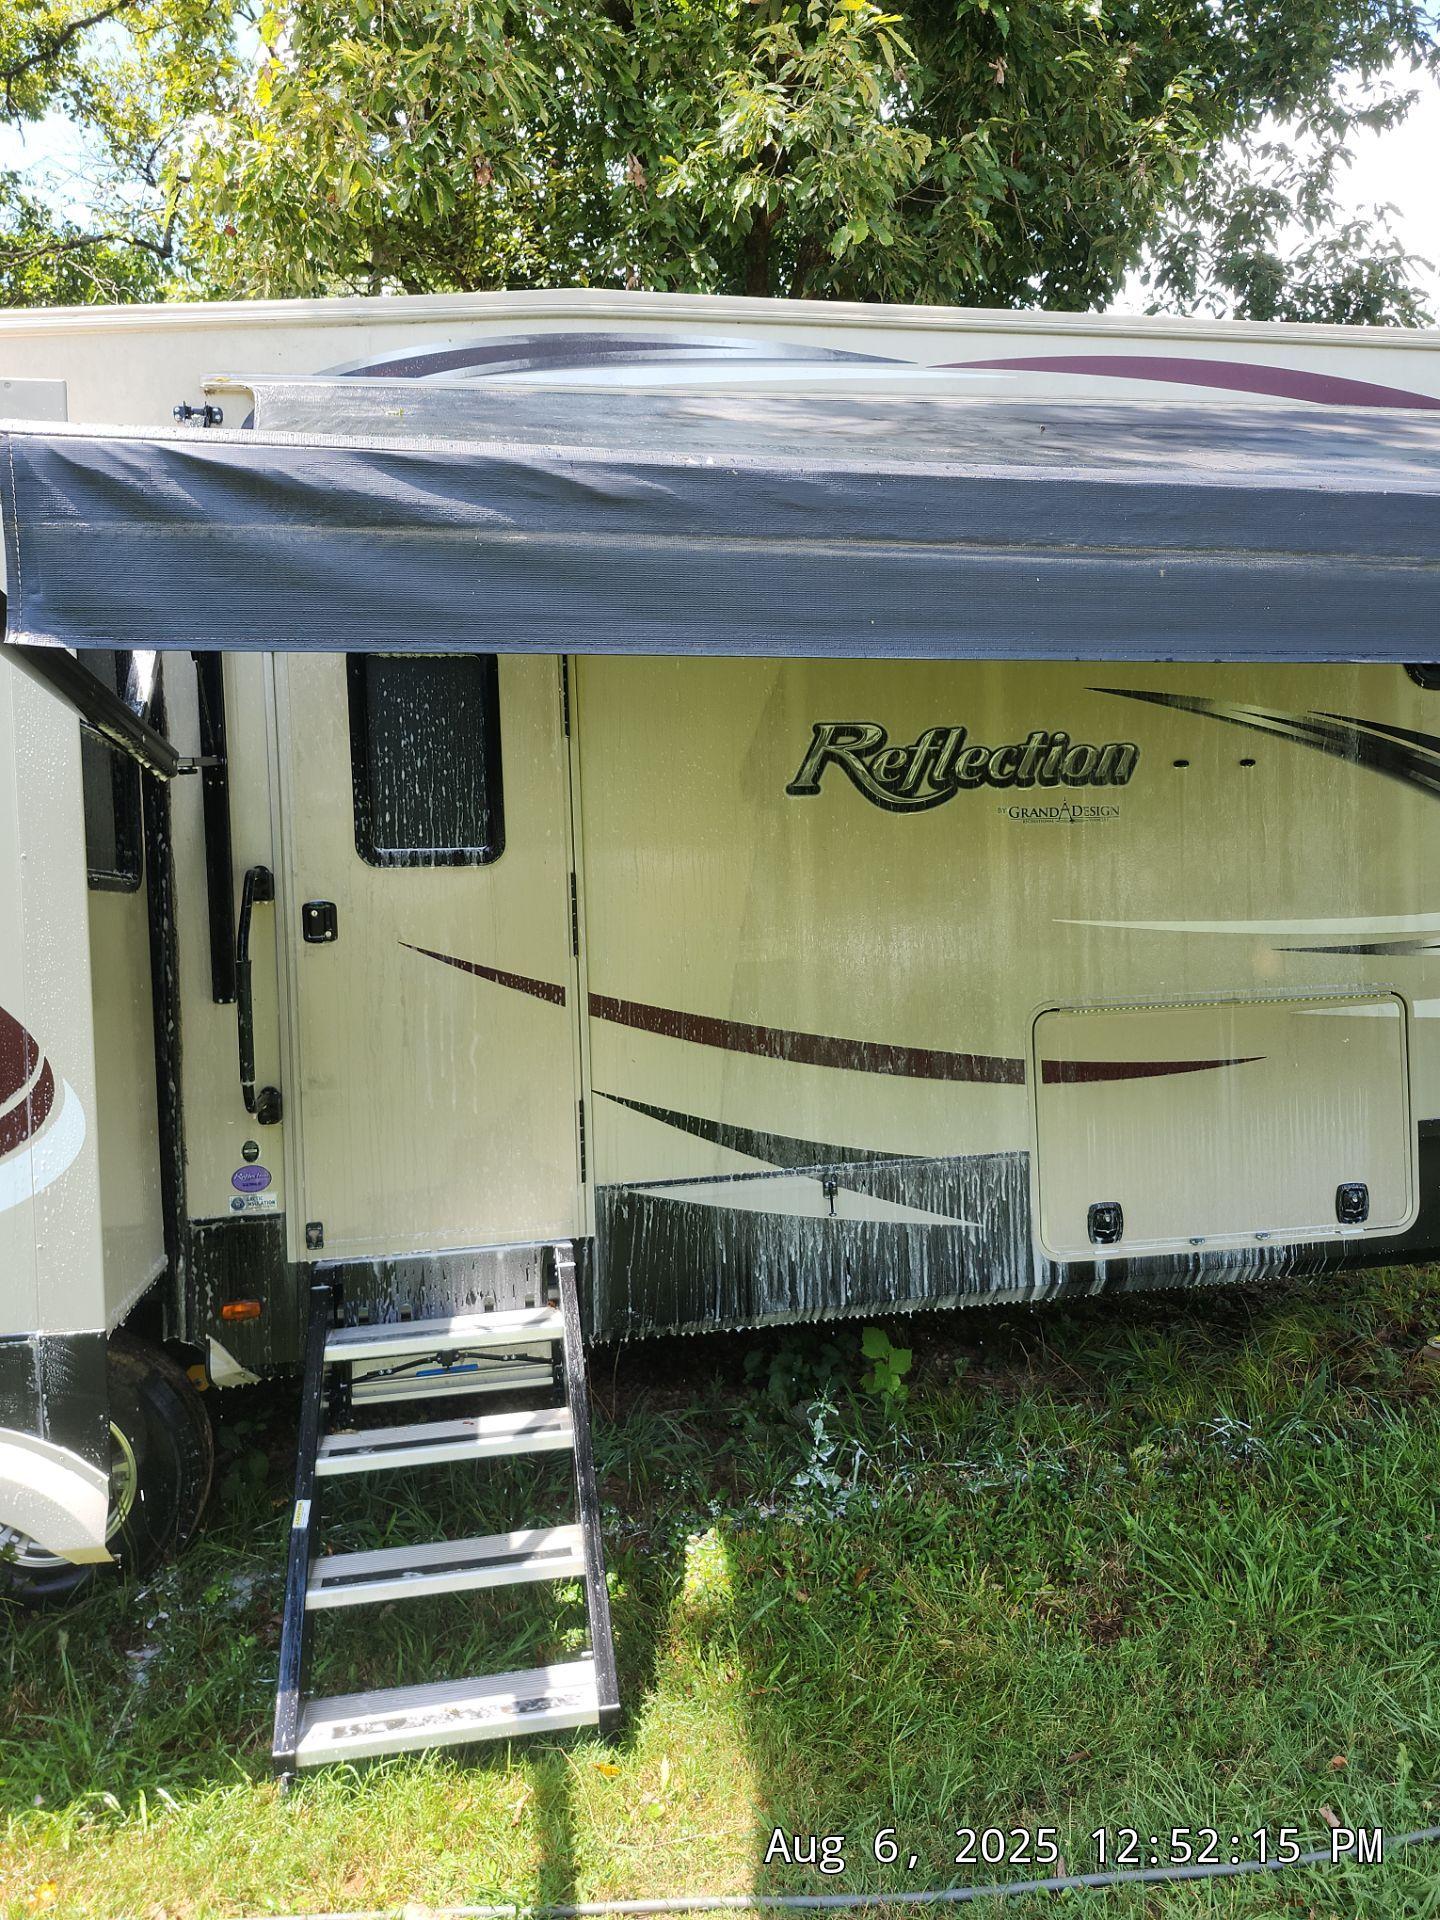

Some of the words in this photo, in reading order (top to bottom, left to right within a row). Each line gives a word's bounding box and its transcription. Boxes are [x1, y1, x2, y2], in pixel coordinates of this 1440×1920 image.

[786, 722, 1140, 813] Reflection
[1008, 806, 1060, 818] GRAND
[1072, 805, 1120, 817] DESIGN
